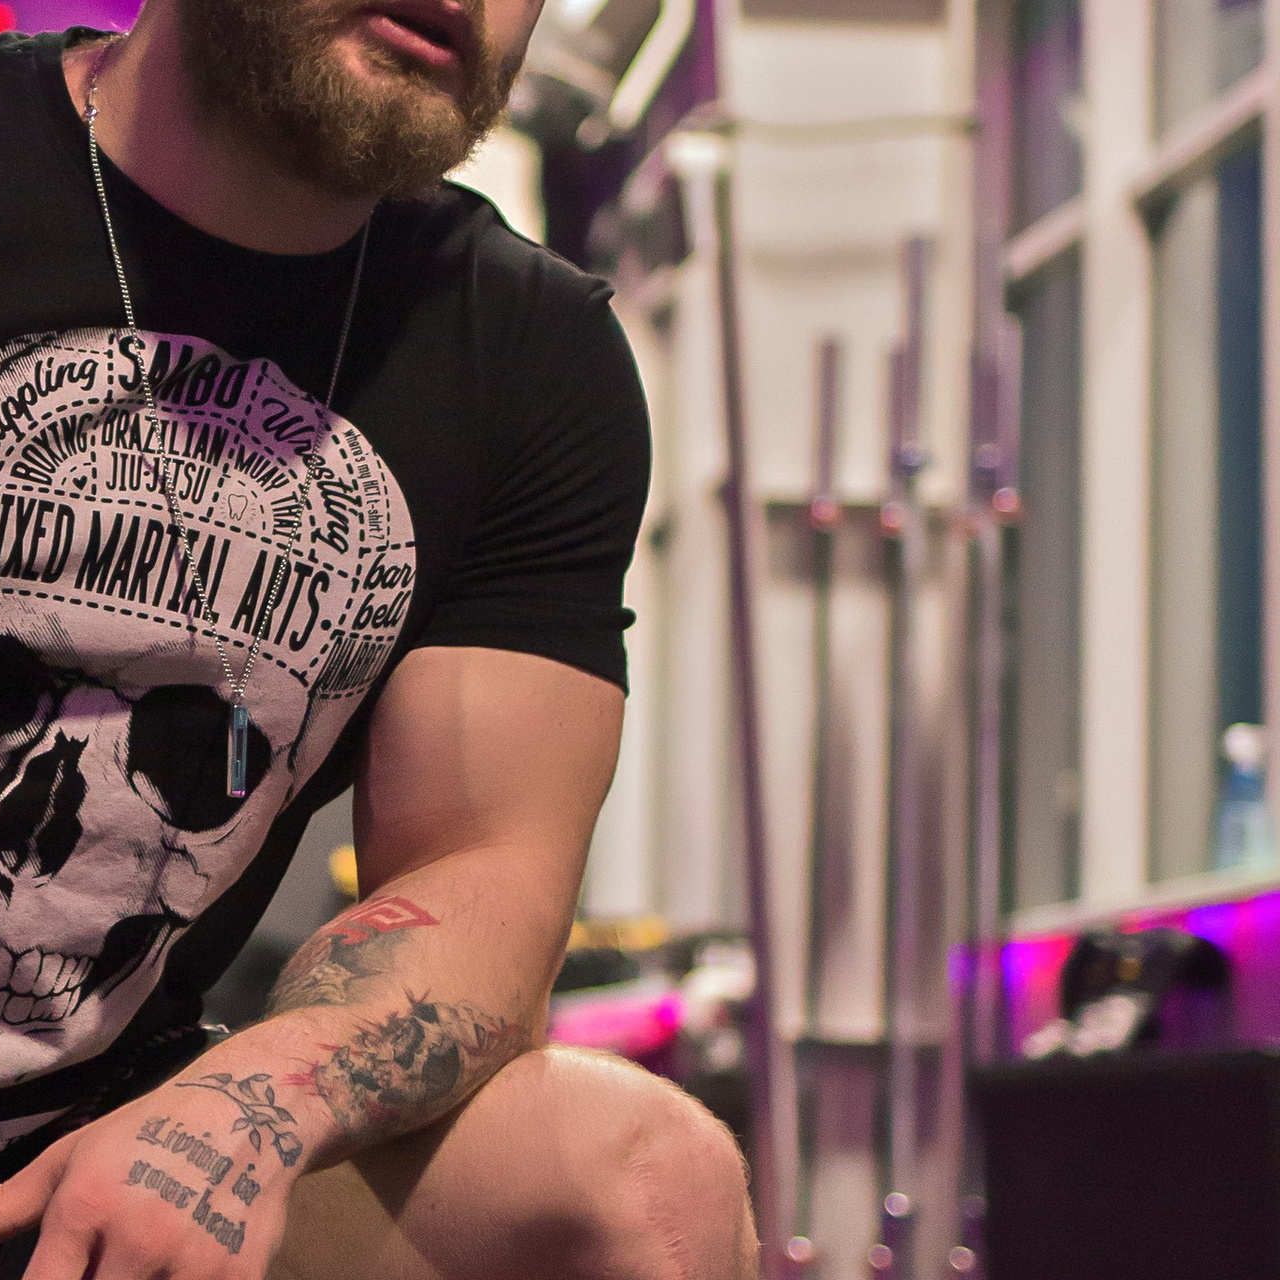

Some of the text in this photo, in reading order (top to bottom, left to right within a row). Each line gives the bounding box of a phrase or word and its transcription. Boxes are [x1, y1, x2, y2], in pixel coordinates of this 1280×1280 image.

[118, 335, 250, 410] SAMBO
[11, 412, 94, 486] BOXING
[101, 408, 230, 468] BRAZILIAN
[343, 428, 368, 463] where's
[234, 443, 303, 543] MUAY THAI
[357, 463, 372, 482] my
[362, 479, 382, 498] HCT
[74, 510, 231, 624] MARTIAL
[362, 552, 417, 590] bar
[351, 589, 412, 630] bell
